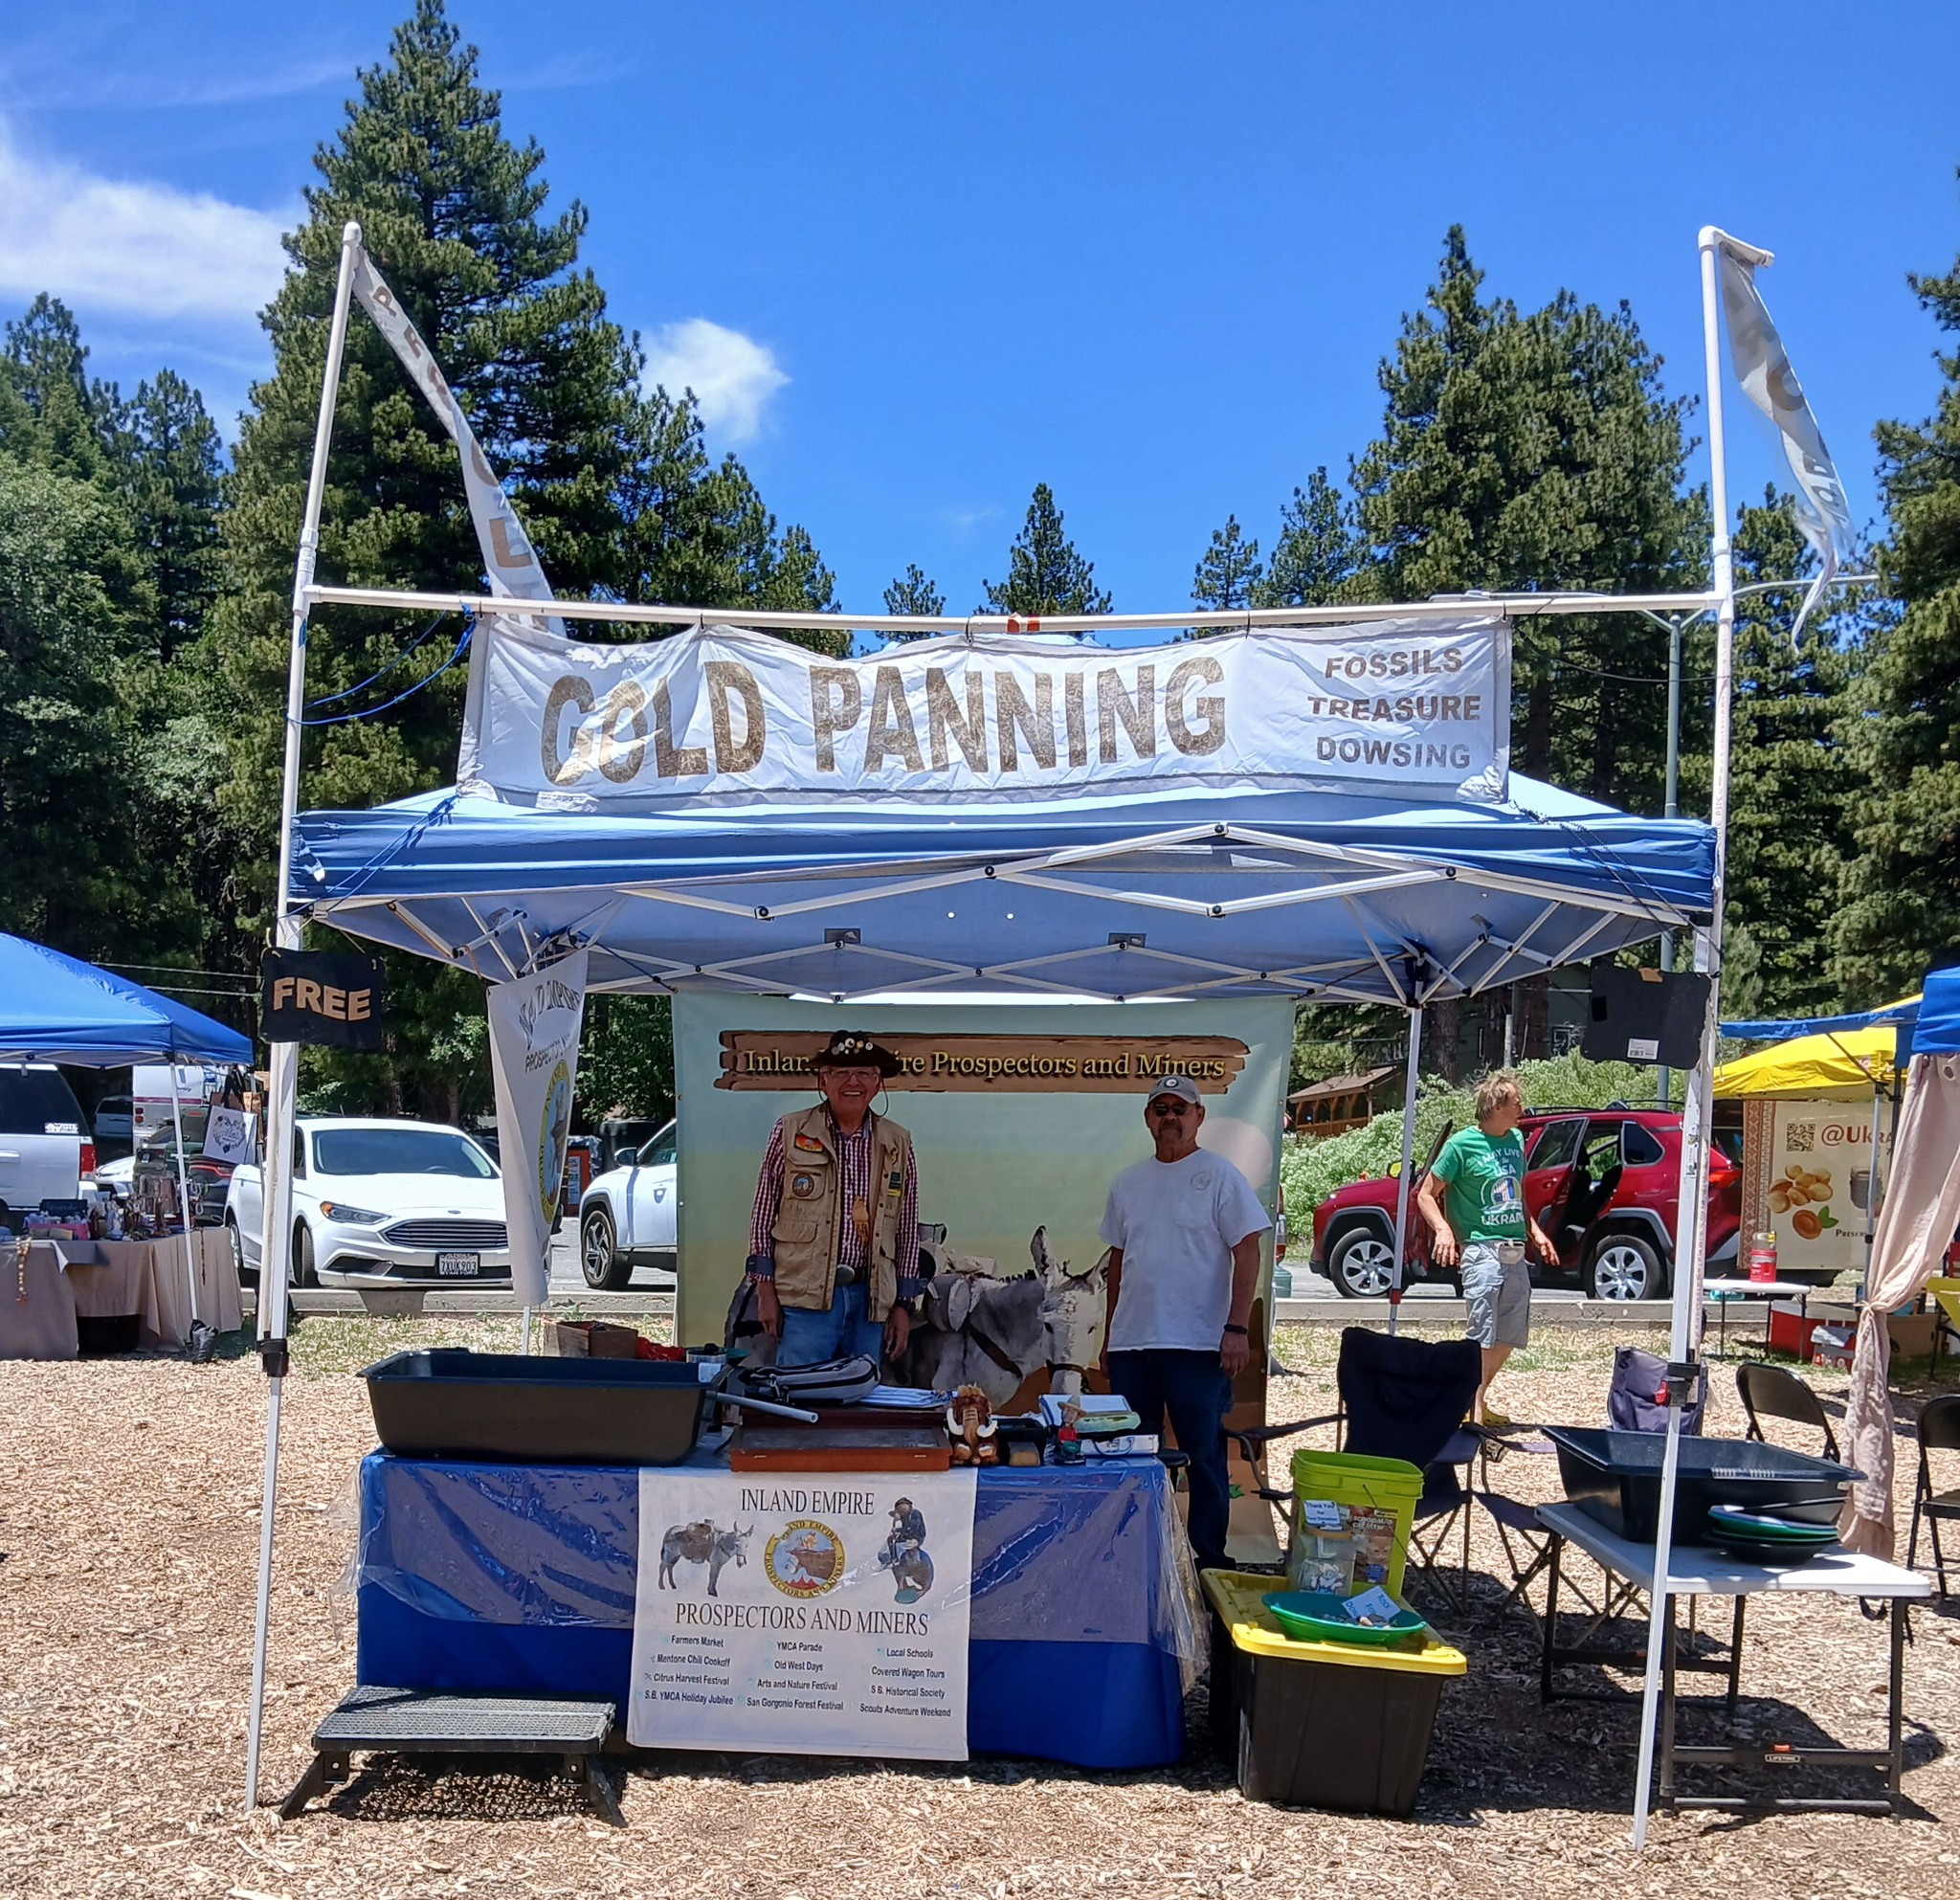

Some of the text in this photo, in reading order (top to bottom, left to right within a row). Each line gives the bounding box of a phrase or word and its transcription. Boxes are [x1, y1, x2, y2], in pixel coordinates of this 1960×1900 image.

[1325, 647, 1462, 679] FOSSILS
[1307, 695, 1481, 722] TREASURE
[541, 656, 1226, 787] GOLD PANNING
[1317, 739, 1470, 768] DOWSING
[274, 976, 371, 1021] FREE
[746, 1050, 819, 1072] Inlan
[931, 1052, 1077, 1079] Prospectors
[1083, 1053, 1129, 1074] and
[1138, 1054, 1225, 1077] Miners
[1503, 1148, 1520, 1158] LIVE
[1493, 1163, 1516, 1176] USA
[741, 1488, 875, 1515] INLAND EMPIRE
[675, 1602, 928, 1637] PROSPECTORS AND MINERS
[672, 1635, 724, 1647] Farmers Market
[777, 1642, 822, 1652] YMCA Parade
[657, 1654, 685, 1664] Mentone
[886, 1647, 933, 1658] Local Schools
[774, 1660, 823, 1673] Old West Days
[872, 1666, 945, 1680] Covered Wagon Tours
[654, 1673, 729, 1686] Citrus Harvest Festival
[757, 1679, 771, 1688] Arts
[788, 1680, 810, 1689] Nature
[812, 1681, 837, 1691] Festival
[681, 1691, 707, 1705] Holiday
[709, 1694, 734, 1705] Jubilee
[886, 1687, 918, 1697] Historical
[920, 1688, 946, 1700] Society
[747, 1697, 844, 1710] San Gorgonio Forest Festival
[860, 1703, 951, 1717] Scouts Adventure Weekend
